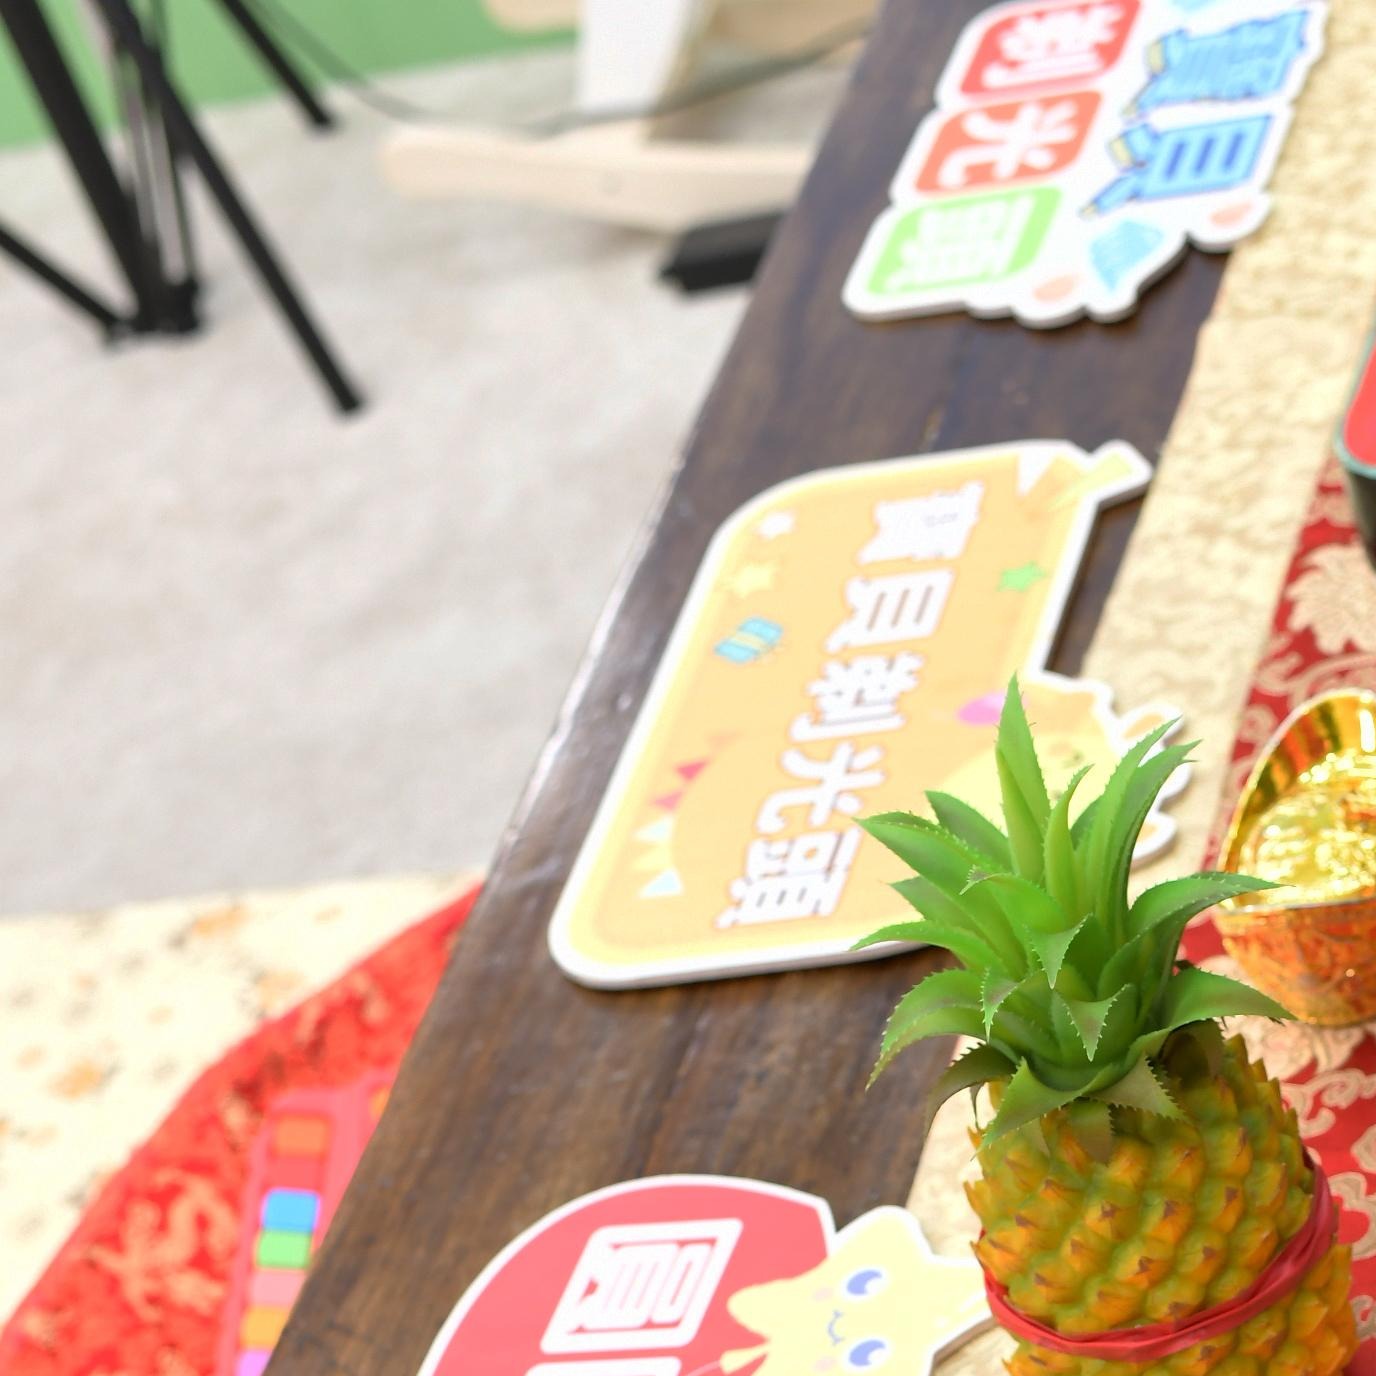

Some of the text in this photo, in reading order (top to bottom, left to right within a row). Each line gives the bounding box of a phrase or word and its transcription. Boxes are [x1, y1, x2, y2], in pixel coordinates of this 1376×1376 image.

[716, 480, 985, 929] 寶貝剃光頭
